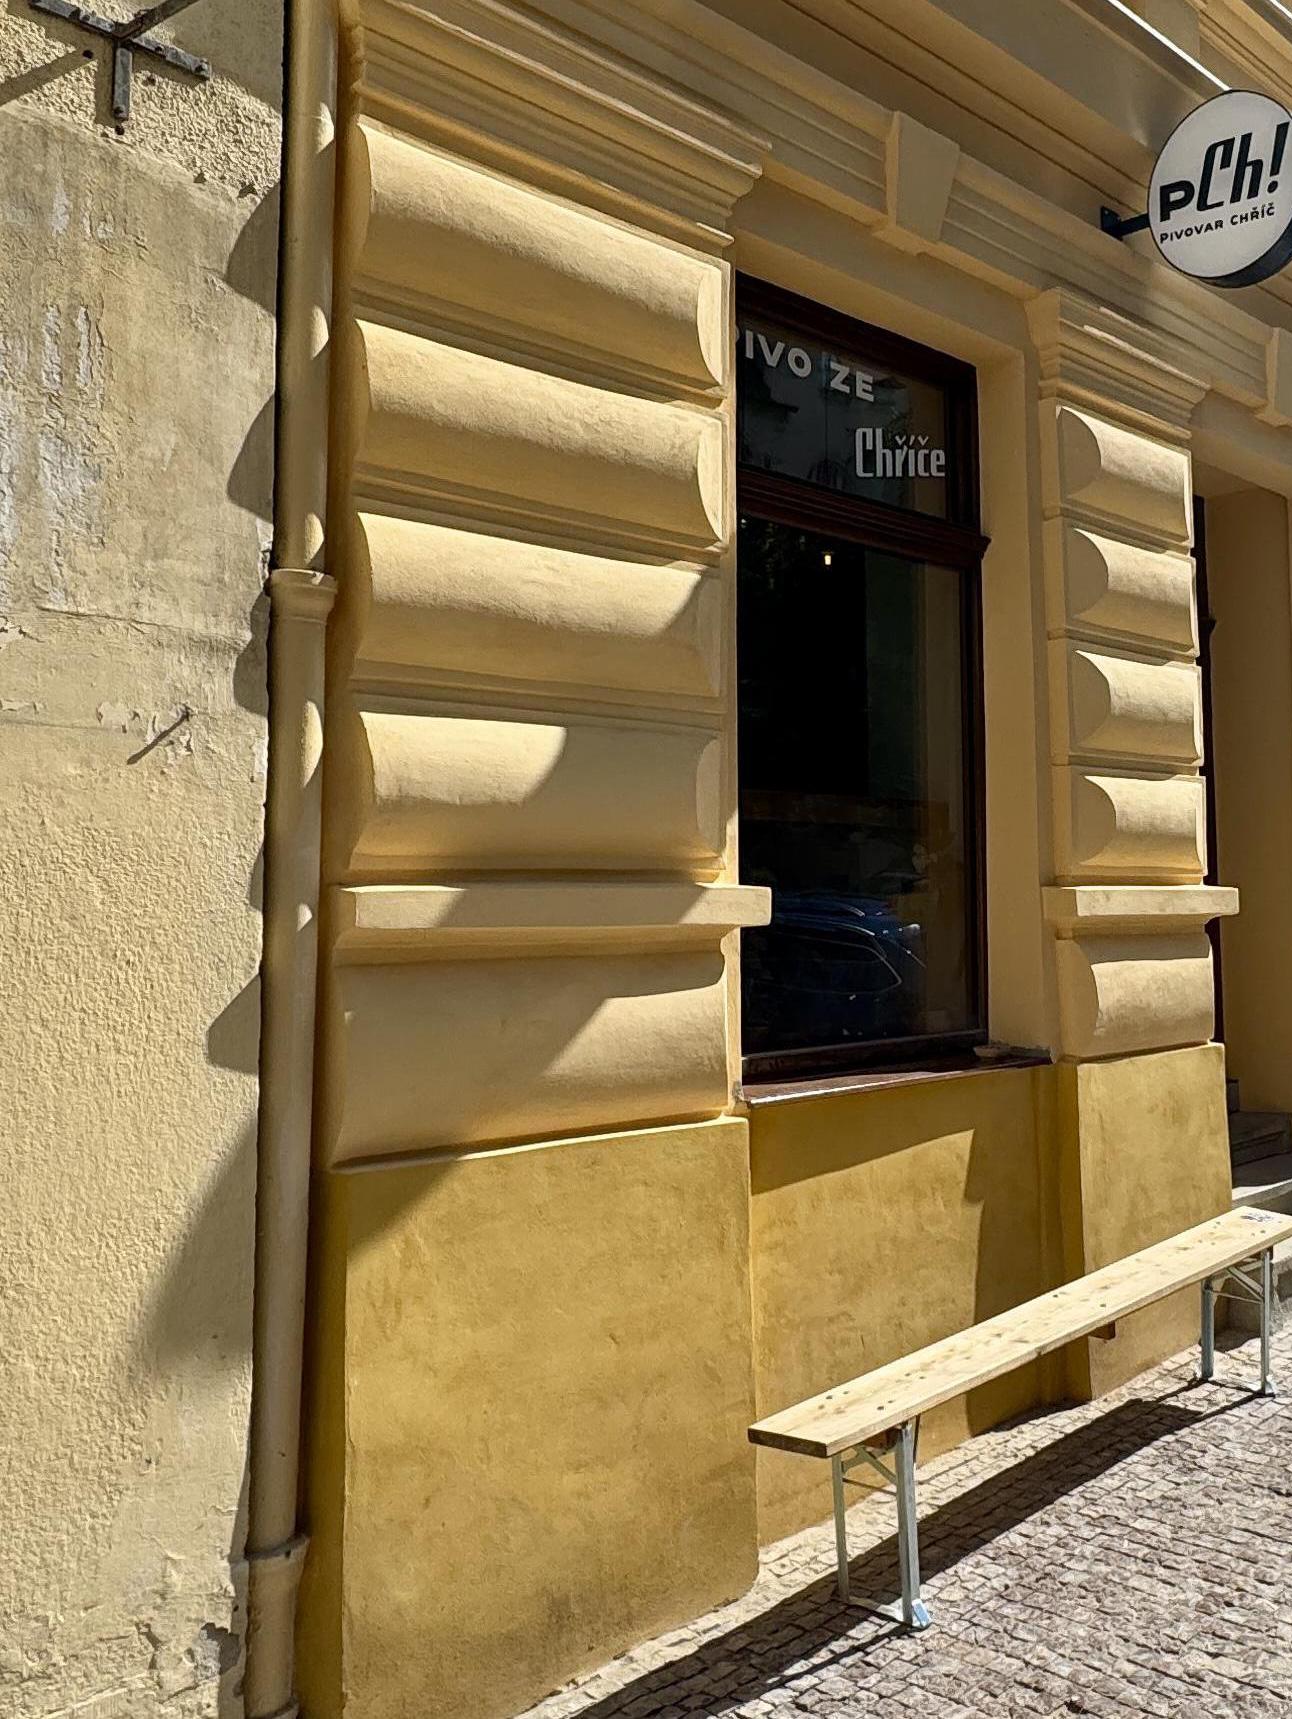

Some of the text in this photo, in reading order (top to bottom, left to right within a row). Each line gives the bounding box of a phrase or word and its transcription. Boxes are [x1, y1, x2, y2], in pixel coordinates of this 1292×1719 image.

[1160, 202, 1275, 244] PIVOVAR CHŘÍČ
[736, 326, 874, 402] IVO ZE
[856, 427, 945, 477] Chříče
